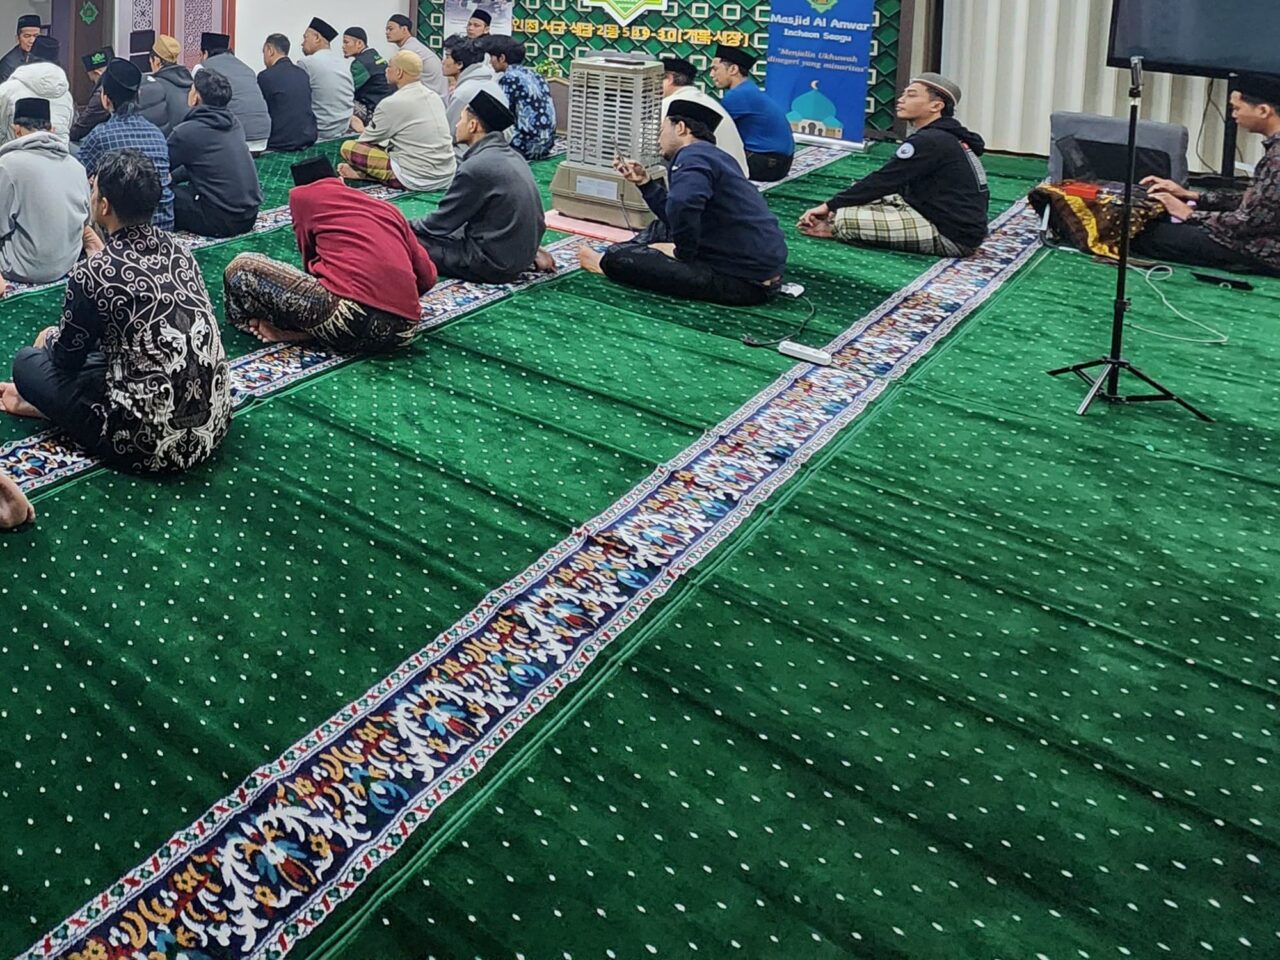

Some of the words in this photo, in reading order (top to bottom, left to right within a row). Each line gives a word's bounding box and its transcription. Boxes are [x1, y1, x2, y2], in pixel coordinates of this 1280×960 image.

[770, 14, 811, 26] Masjid
[813, 17, 827, 27] Al
[830, 19, 870, 31] Anwar
[783, 28, 820, 39] Incheon
[823, 32, 852, 43] Seogu
[801, 60, 822, 69] yang
